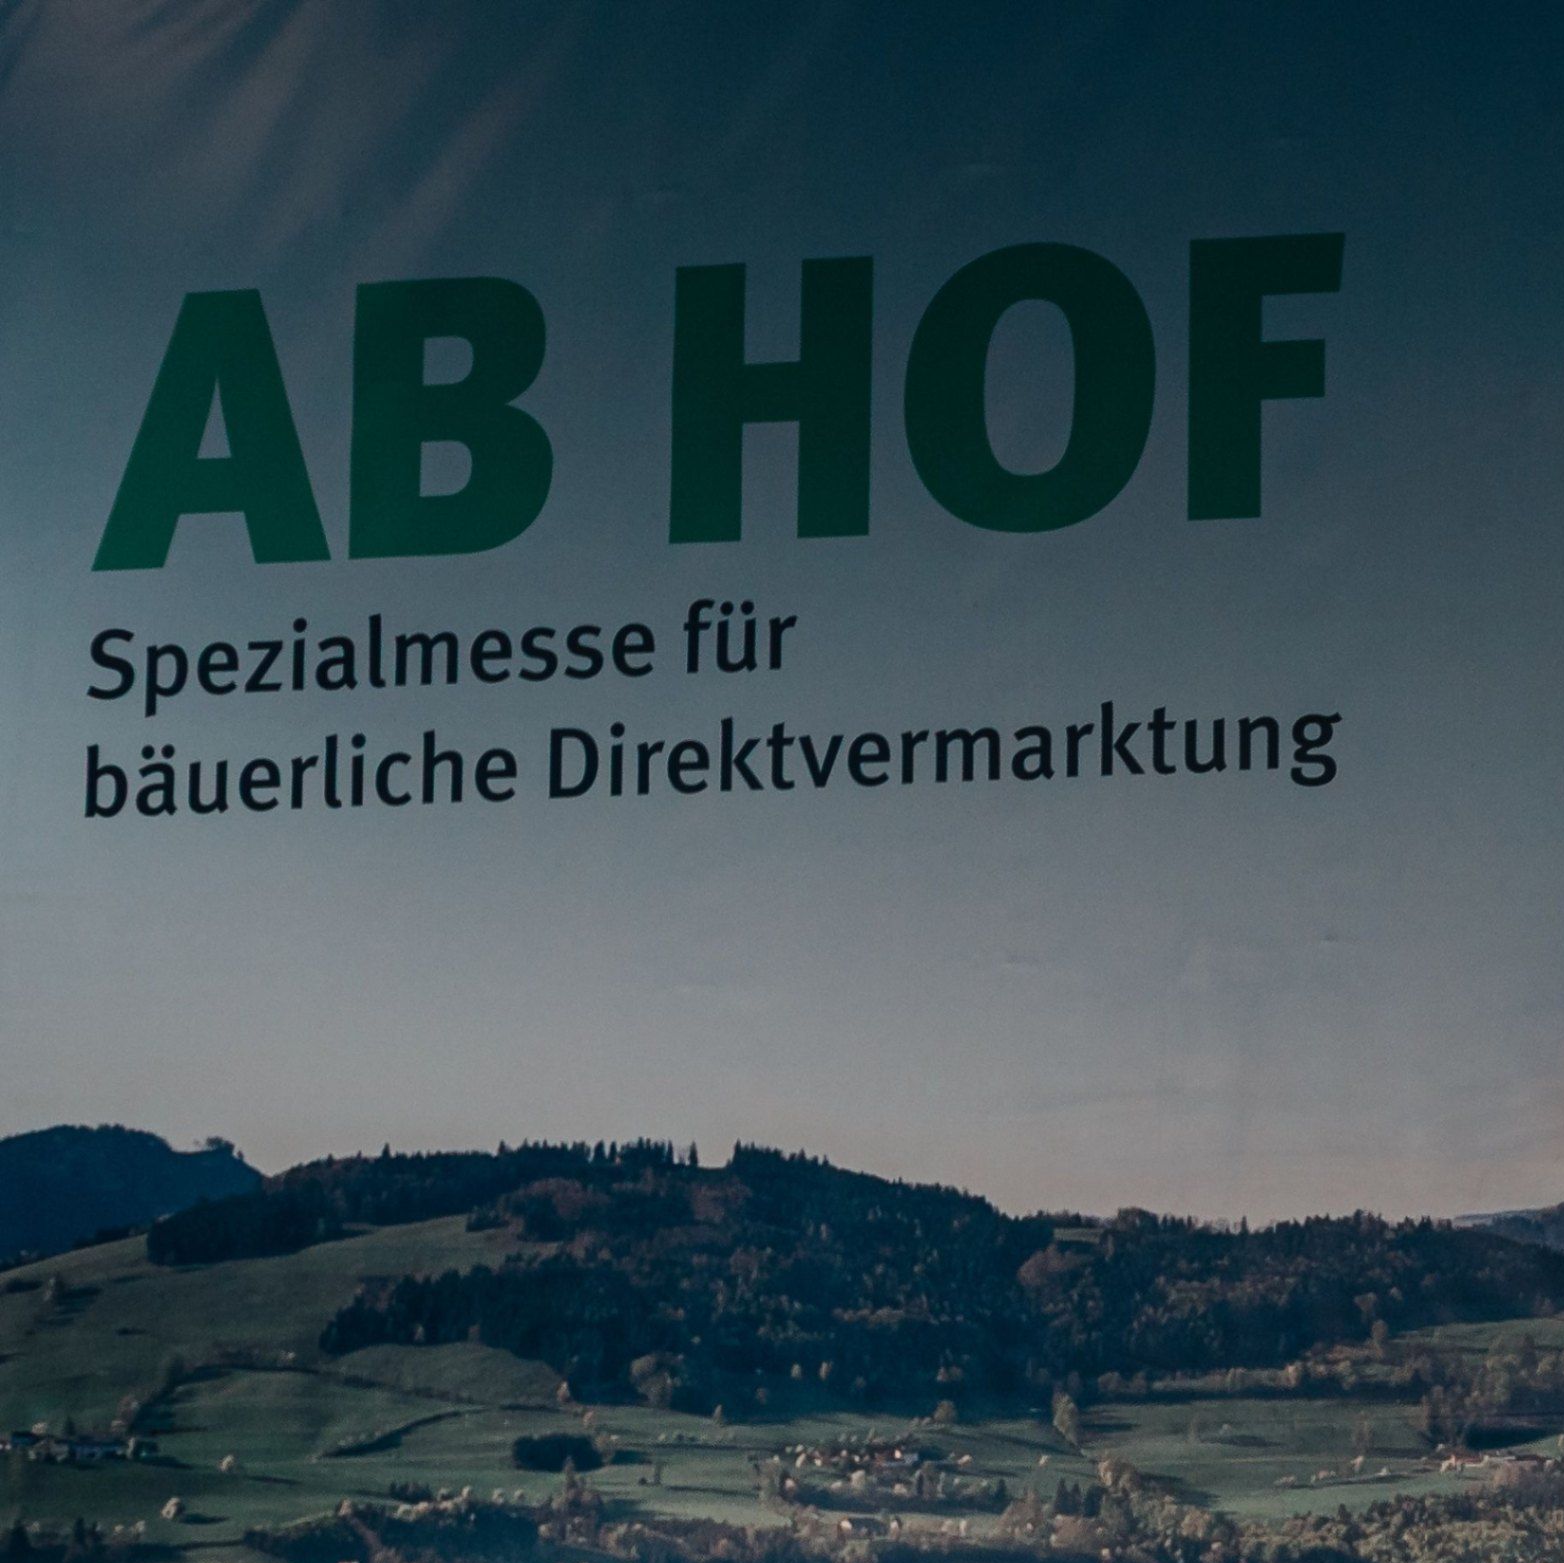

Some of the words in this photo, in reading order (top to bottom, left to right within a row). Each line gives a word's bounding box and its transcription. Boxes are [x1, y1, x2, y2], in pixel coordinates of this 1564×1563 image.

[91, 275, 554, 572] AB
[668, 231, 1345, 545] HOF
[86, 613, 656, 717] Spezialmesse
[683, 600, 798, 674] für
[84, 730, 518, 819] bäuerliche
[548, 701, 1343, 800] Direktvermarktung
